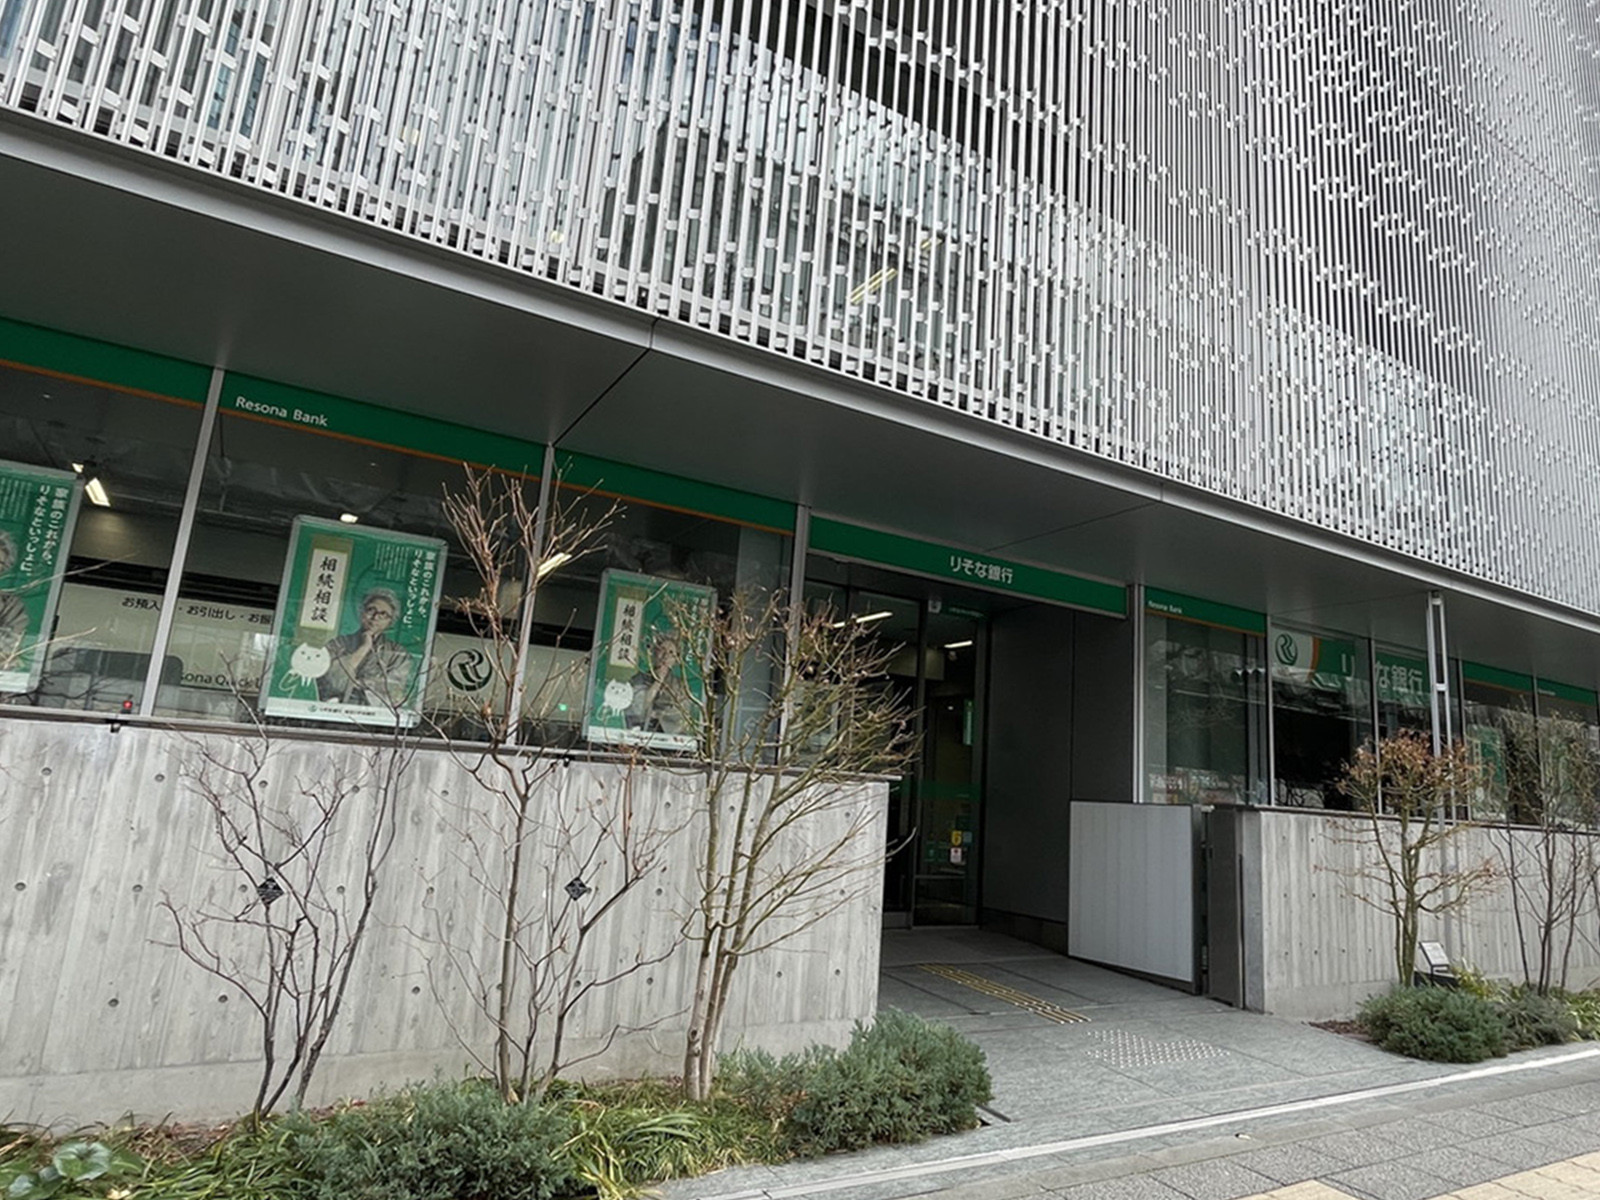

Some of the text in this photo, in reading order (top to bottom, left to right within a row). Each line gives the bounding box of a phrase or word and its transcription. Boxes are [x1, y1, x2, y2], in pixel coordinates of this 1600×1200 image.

[235, 396, 328, 427] Resona Bank
[950, 555, 1014, 584] りそな銀行
[310, 556, 338, 623] 相続相談
